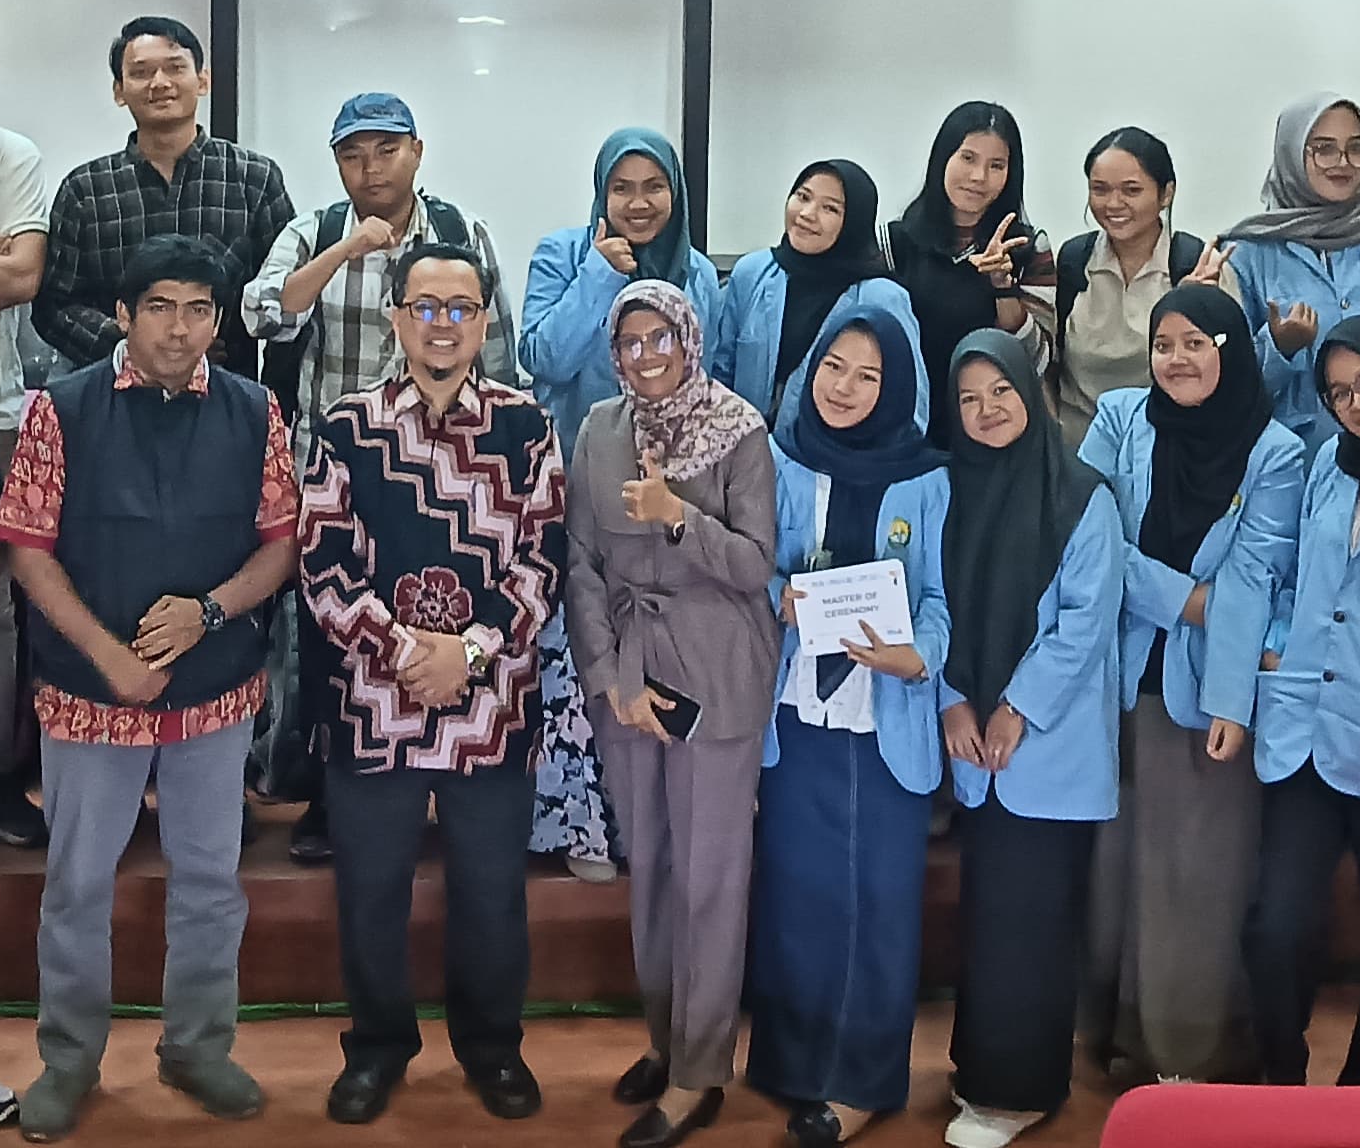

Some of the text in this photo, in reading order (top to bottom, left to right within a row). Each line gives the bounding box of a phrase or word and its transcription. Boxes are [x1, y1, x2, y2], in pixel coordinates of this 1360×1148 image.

[821, 591, 878, 605] MASTER OF
[824, 605, 880, 619] CEREMONY
